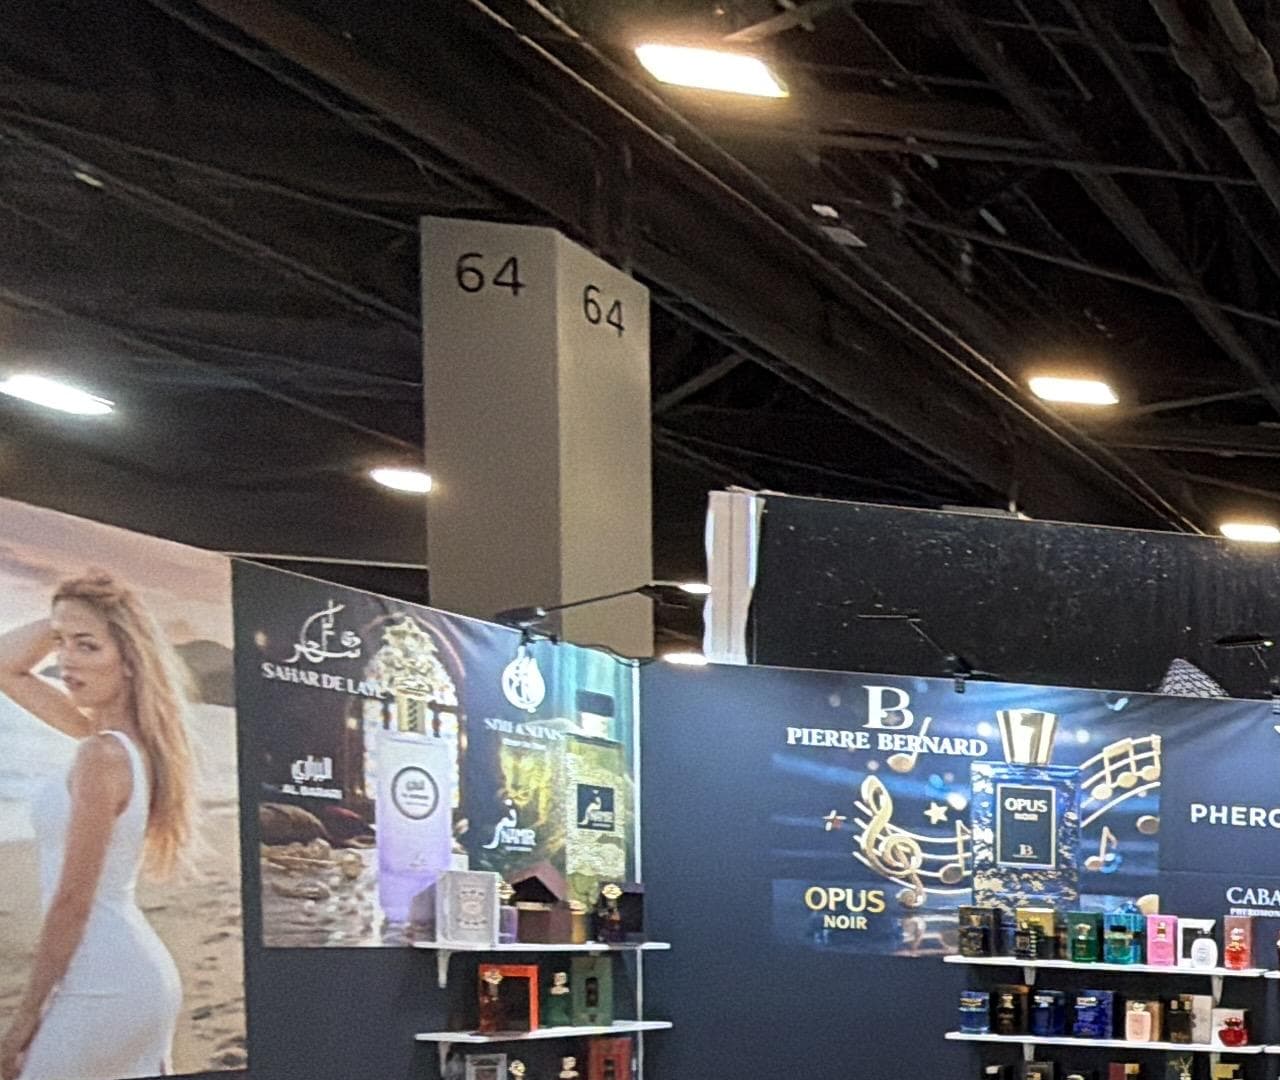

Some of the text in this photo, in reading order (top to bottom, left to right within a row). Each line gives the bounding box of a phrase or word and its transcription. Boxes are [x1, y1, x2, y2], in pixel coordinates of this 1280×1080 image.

[456, 252, 527, 297] 64
[583, 284, 626, 338] 64
[260, 661, 319, 688] SAHAR
[321, 672, 346, 692] DE
[786, 726, 989, 757] PIERRE BERNARD
[1004, 797, 1049, 813] OPUS
[804, 885, 887, 914] OPUS
[823, 914, 869, 931] NOIR
